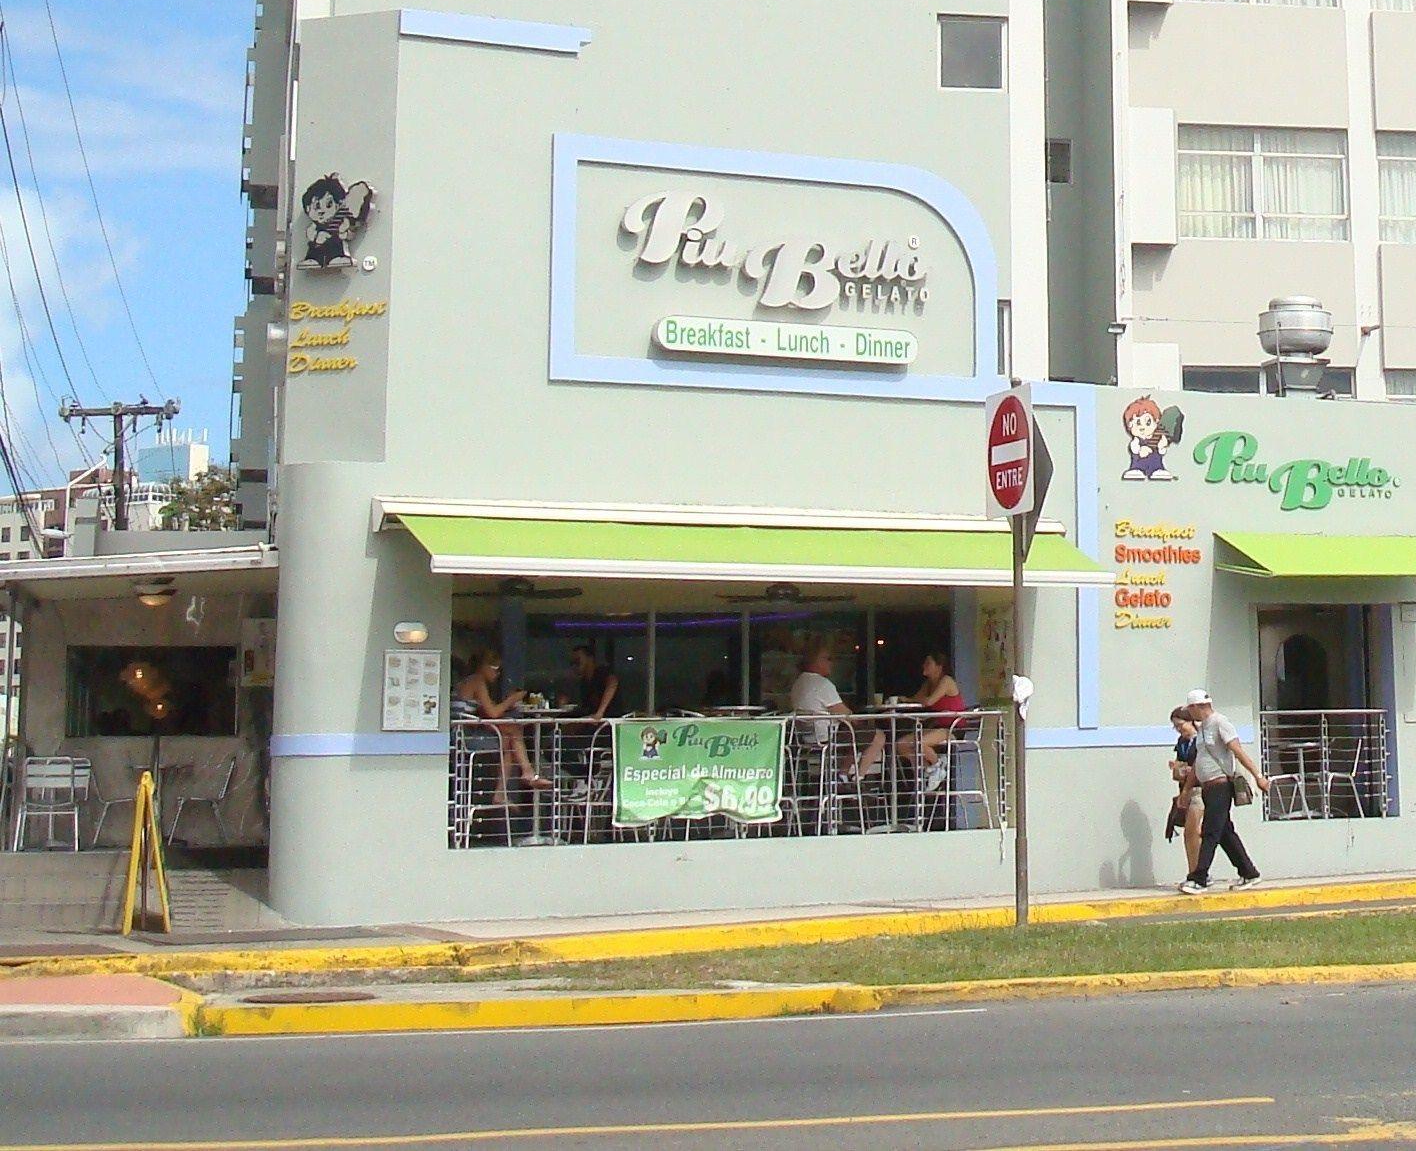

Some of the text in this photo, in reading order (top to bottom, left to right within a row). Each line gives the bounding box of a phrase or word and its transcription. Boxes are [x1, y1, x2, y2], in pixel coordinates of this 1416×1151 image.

[621, 187, 927, 310] Piu Bello
[844, 281, 930, 302] GELATO
[289, 298, 386, 323] Breakfast
[289, 326, 350, 349] Lunch
[666, 320, 750, 349] Breakfast
[777, 327, 830, 353] Lunch
[855, 332, 911, 358] Dinner
[287, 352, 358, 373] Dinner
[1002, 412, 1017, 437] NO
[996, 466, 1023, 490] ENTRE
[1193, 430, 1391, 511] Piu Bello
[1337, 488, 1392, 499] GELATO
[1114, 544, 1202, 564] Smoothies
[1114, 588, 1172, 608] Gelato
[1115, 610, 1172, 629] Dinner
[624, 764, 773, 784] Especial de Almuerzo
